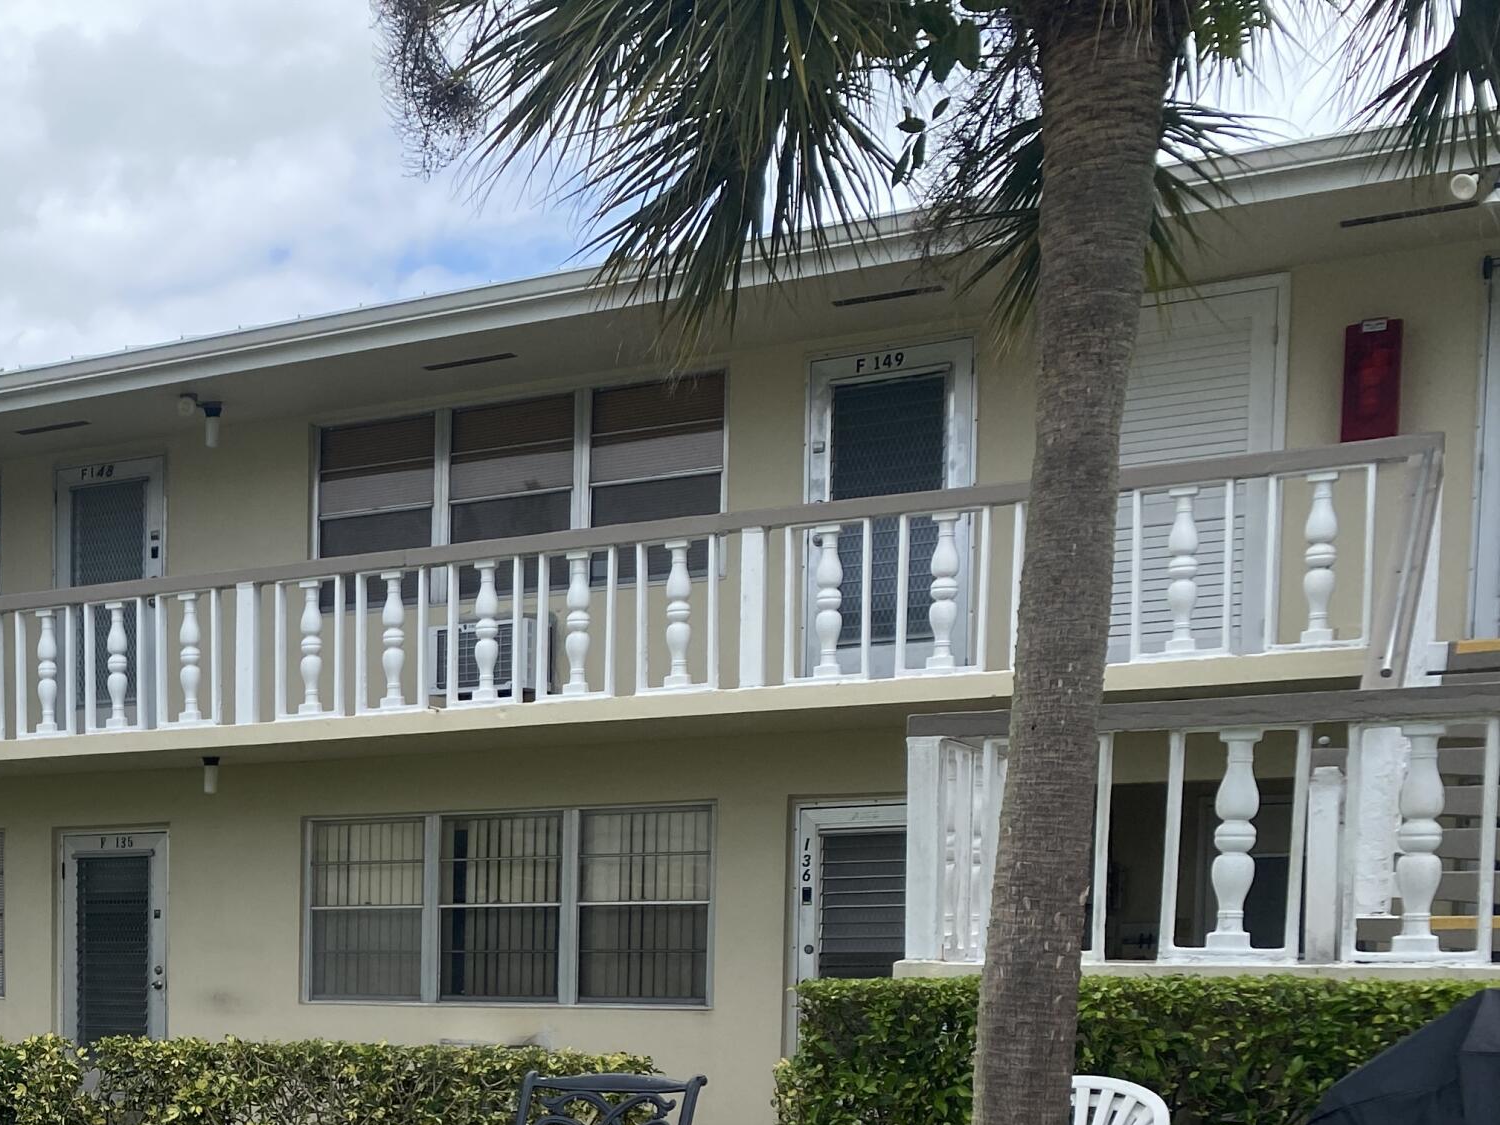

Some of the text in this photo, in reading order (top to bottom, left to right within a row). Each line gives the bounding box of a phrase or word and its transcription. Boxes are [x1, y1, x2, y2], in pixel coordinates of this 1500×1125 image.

[856, 352, 905, 373] F 149
[116, 835, 133, 848] 135
[801, 838, 812, 882] 136
